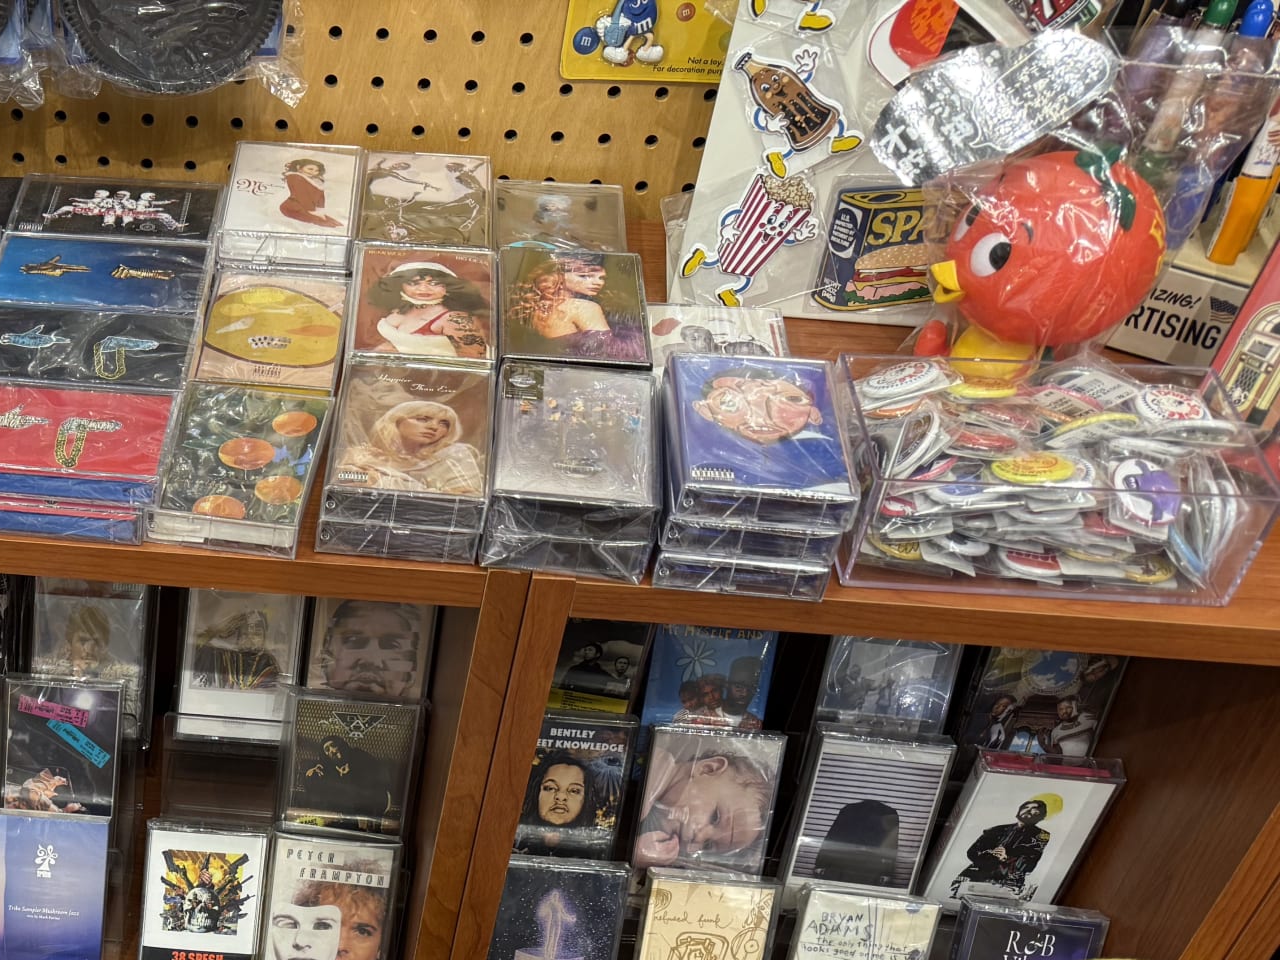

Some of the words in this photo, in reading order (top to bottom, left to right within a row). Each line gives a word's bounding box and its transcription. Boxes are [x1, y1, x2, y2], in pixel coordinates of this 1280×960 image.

[374, 373, 412, 386] Happier
[410, 382, 435, 394] Than
[738, 630, 764, 641] AND
[550, 728, 596, 739] BENTLEY
[286, 848, 336, 863] PETER
[300, 867, 386, 887] FRAMPTON
[821, 912, 864, 924] BRYAN
[806, 919, 874, 942] ADAMS
